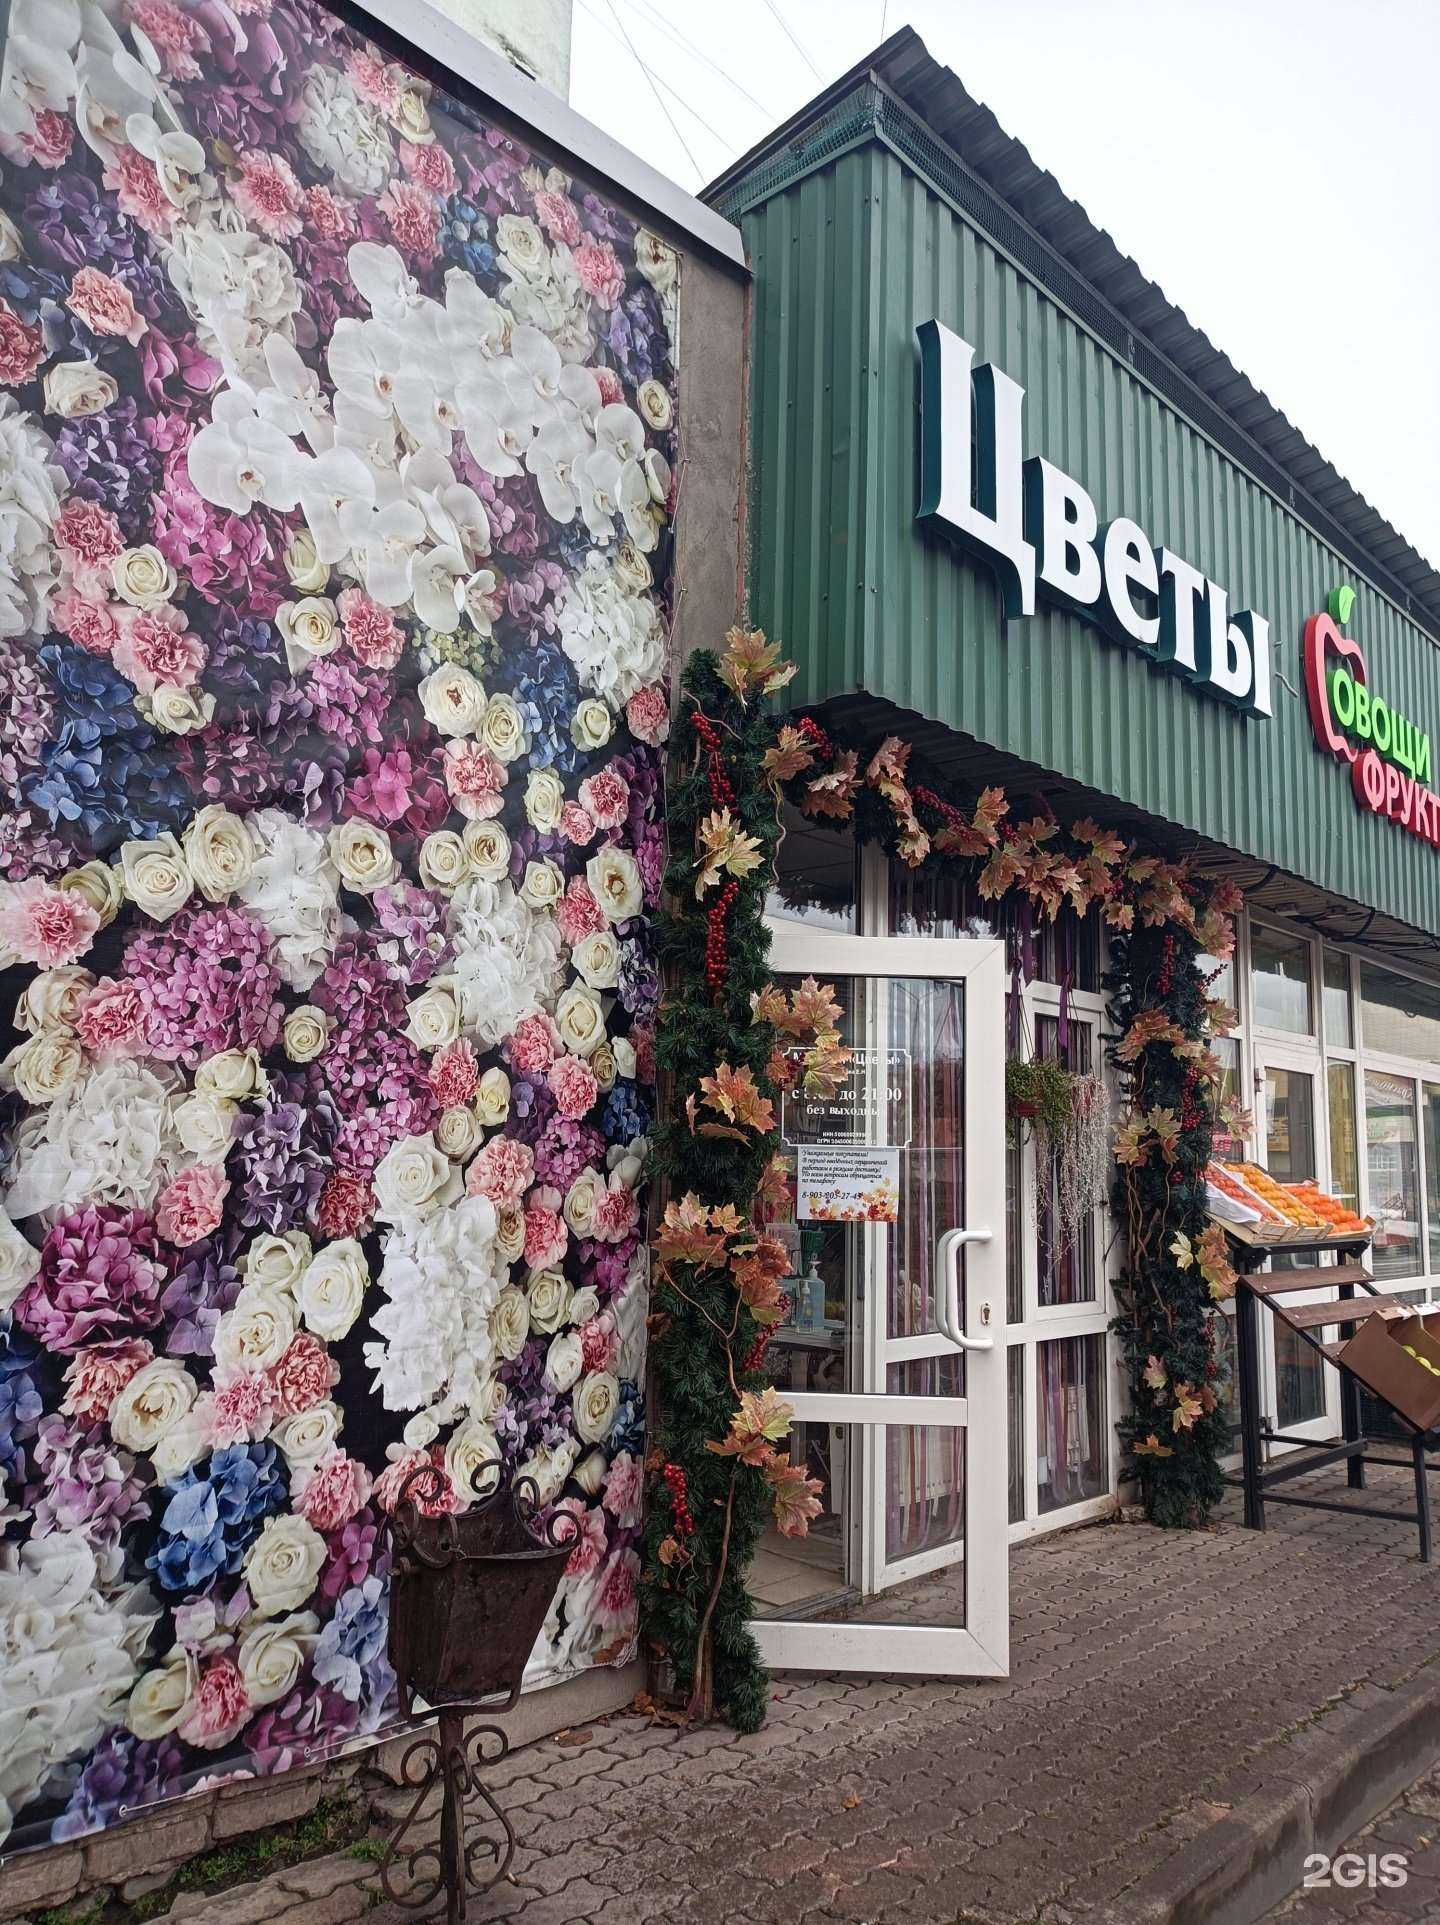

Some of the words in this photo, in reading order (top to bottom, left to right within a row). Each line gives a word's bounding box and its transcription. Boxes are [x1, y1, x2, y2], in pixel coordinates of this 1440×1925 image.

[924, 318, 1273, 719] Цветы
[1333, 668, 1431, 782] ОВОЩИ
[806, 1104, 825, 1115] без
[839, 1090, 857, 1101] до
